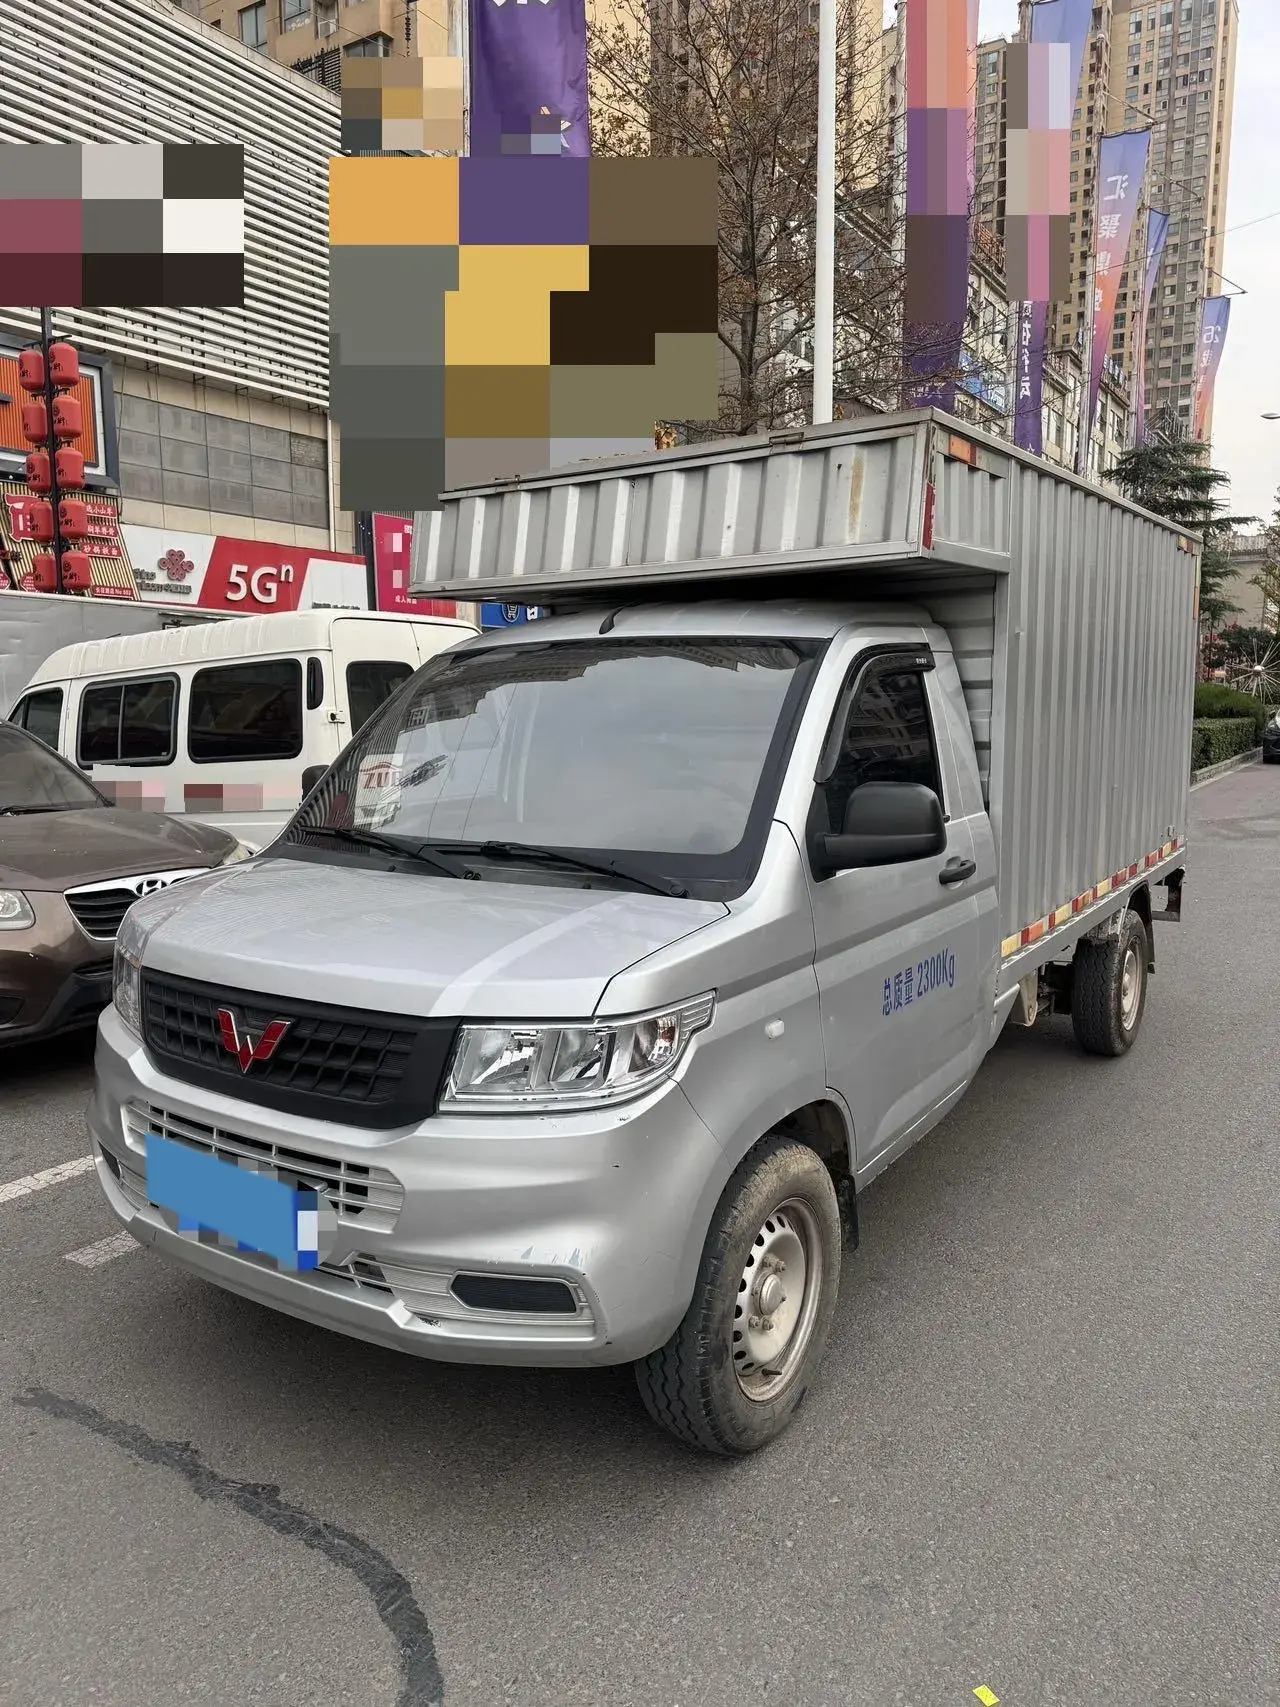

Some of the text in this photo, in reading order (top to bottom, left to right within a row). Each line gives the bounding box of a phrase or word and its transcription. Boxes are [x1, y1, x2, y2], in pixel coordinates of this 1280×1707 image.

[882, 947, 955, 1016] 总质量 2300Kg
